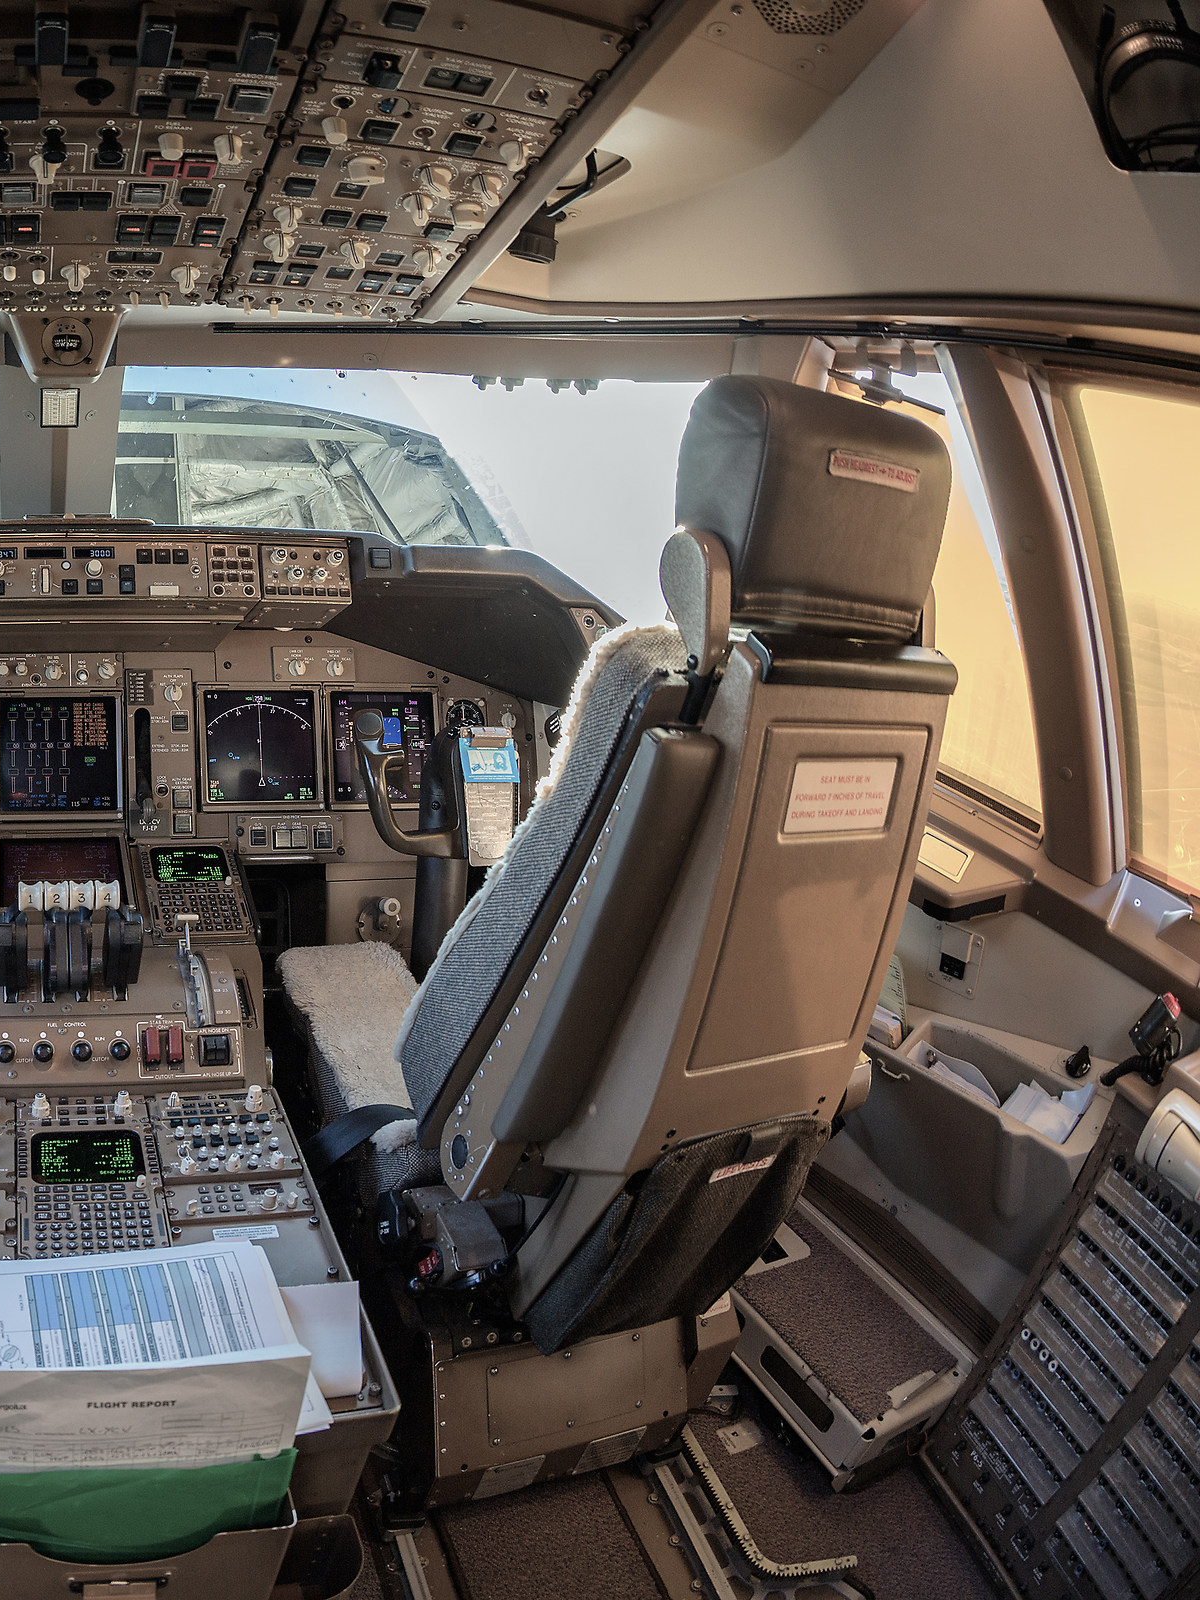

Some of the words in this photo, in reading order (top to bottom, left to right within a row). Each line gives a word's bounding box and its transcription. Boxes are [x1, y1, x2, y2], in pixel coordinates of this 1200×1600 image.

[90, 549, 111, 557] 3000
[795, 792, 826, 801] FORWARD
[791, 810, 815, 819] DURING
[818, 809, 843, 818] TAKEOFF
[845, 809, 857, 817] AND
[858, 807, 883, 816] LANDING
[28, 894, 33, 904] 1
[53, 893, 60, 904] 2
[78, 893, 86, 903] 3
[103, 892, 111, 903] 4
[87, 1401, 127, 1409] FLIGHT
[131, 1400, 177, 1408] REPORT
